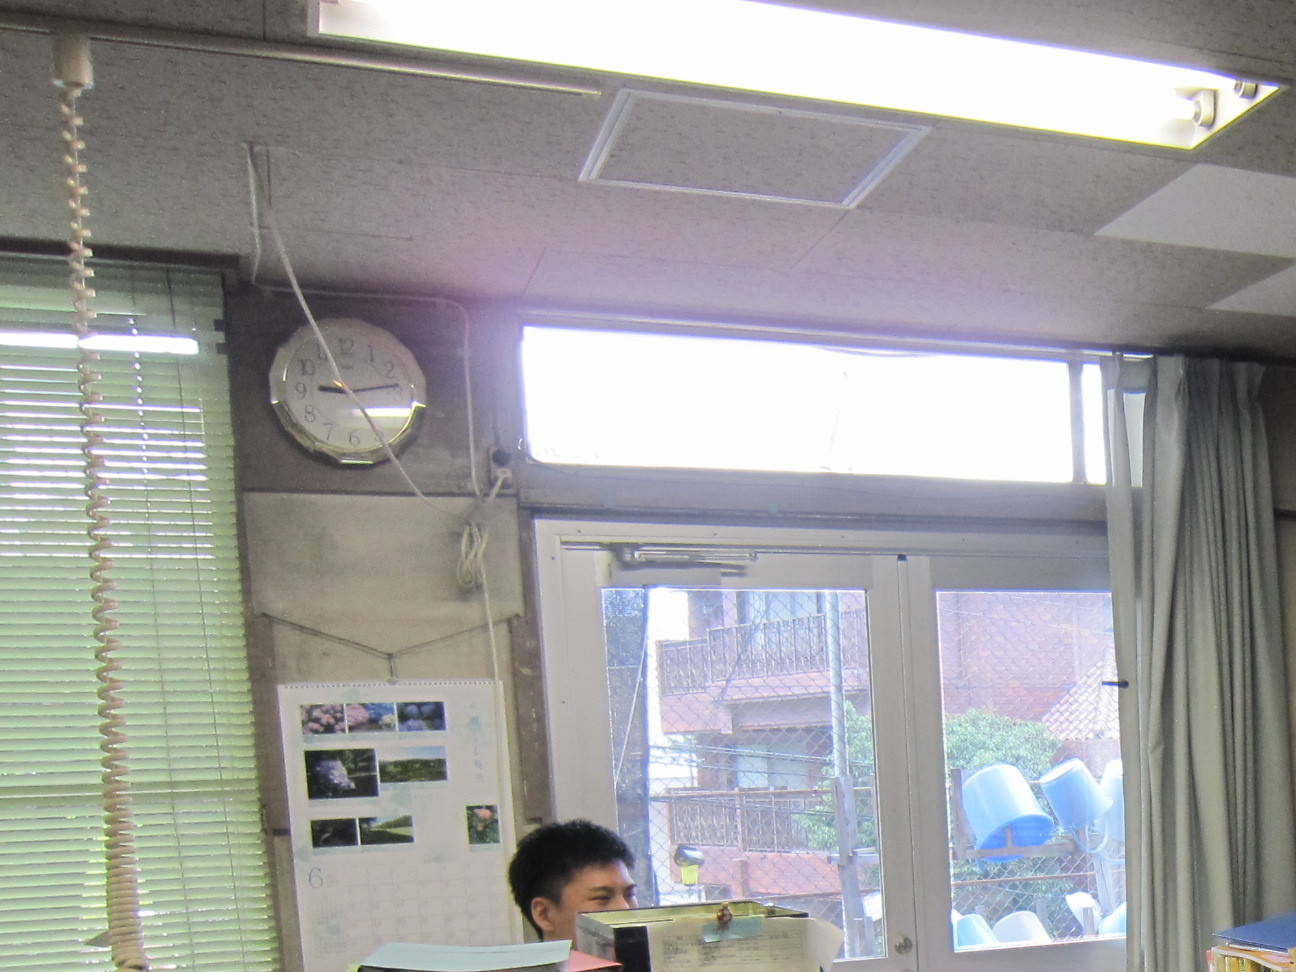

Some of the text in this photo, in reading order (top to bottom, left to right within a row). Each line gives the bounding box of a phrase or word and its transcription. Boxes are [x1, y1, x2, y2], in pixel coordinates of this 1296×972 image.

[339, 337, 354, 353] 12
[368, 344, 375, 362] 1
[300, 359, 316, 376] 10
[384, 362, 396, 379] 2
[295, 383, 307, 400] 9
[304, 406, 317, 423] 8
[323, 422, 335, 441] 7
[348, 431, 361, 446] 6
[308, 867, 324, 888] 6
